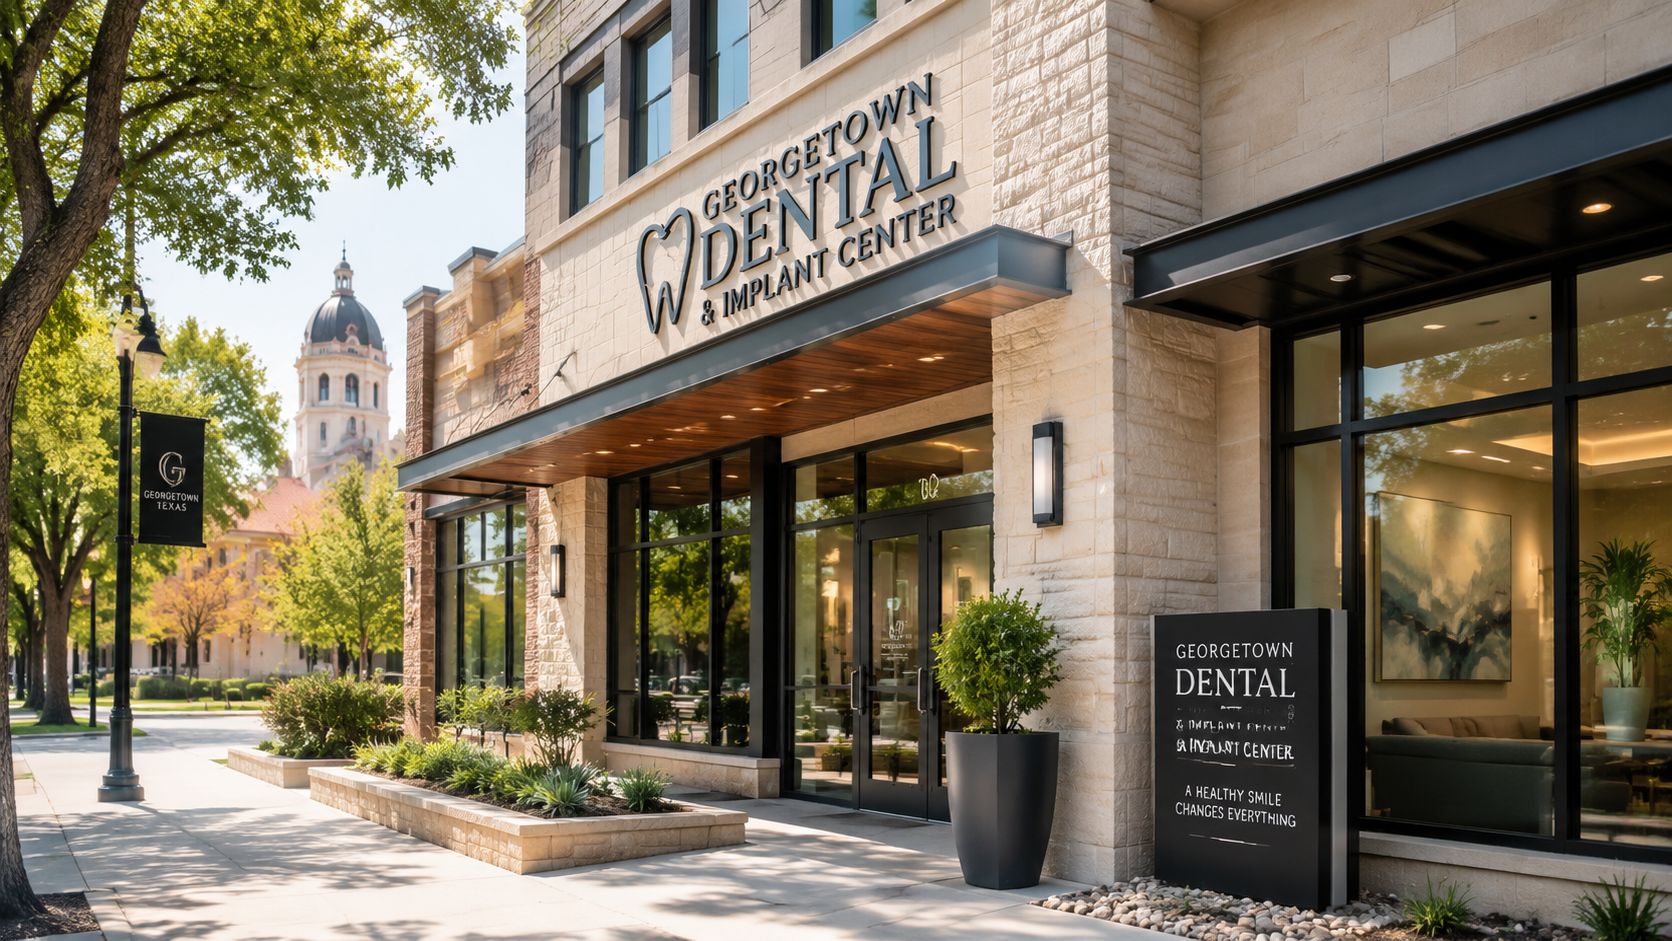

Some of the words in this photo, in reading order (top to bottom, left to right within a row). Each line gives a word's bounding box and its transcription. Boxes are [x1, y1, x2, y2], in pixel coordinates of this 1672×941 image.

[702, 72, 933, 220] GEORGETOWN
[701, 116, 957, 290] DENTAL
[701, 299, 715, 326] &
[722, 248, 828, 318] IMPLANT
[838, 193, 957, 268] CENTER
[144, 490, 199, 503] GEORGETOWN
[157, 501, 187, 512] TEXAS
[1176, 642, 1293, 659] GEORGETOWN
[1176, 668, 1296, 698] DENTAL
[1243, 741, 1295, 760] CENTER
[1185, 785, 1192, 797] A
[1196, 786, 1244, 802] HEALTHY
[1248, 790, 1282, 807] SMILE
[1175, 802, 1224, 819] CHANGES
[1228, 807, 1297, 828] EVERYTHING
